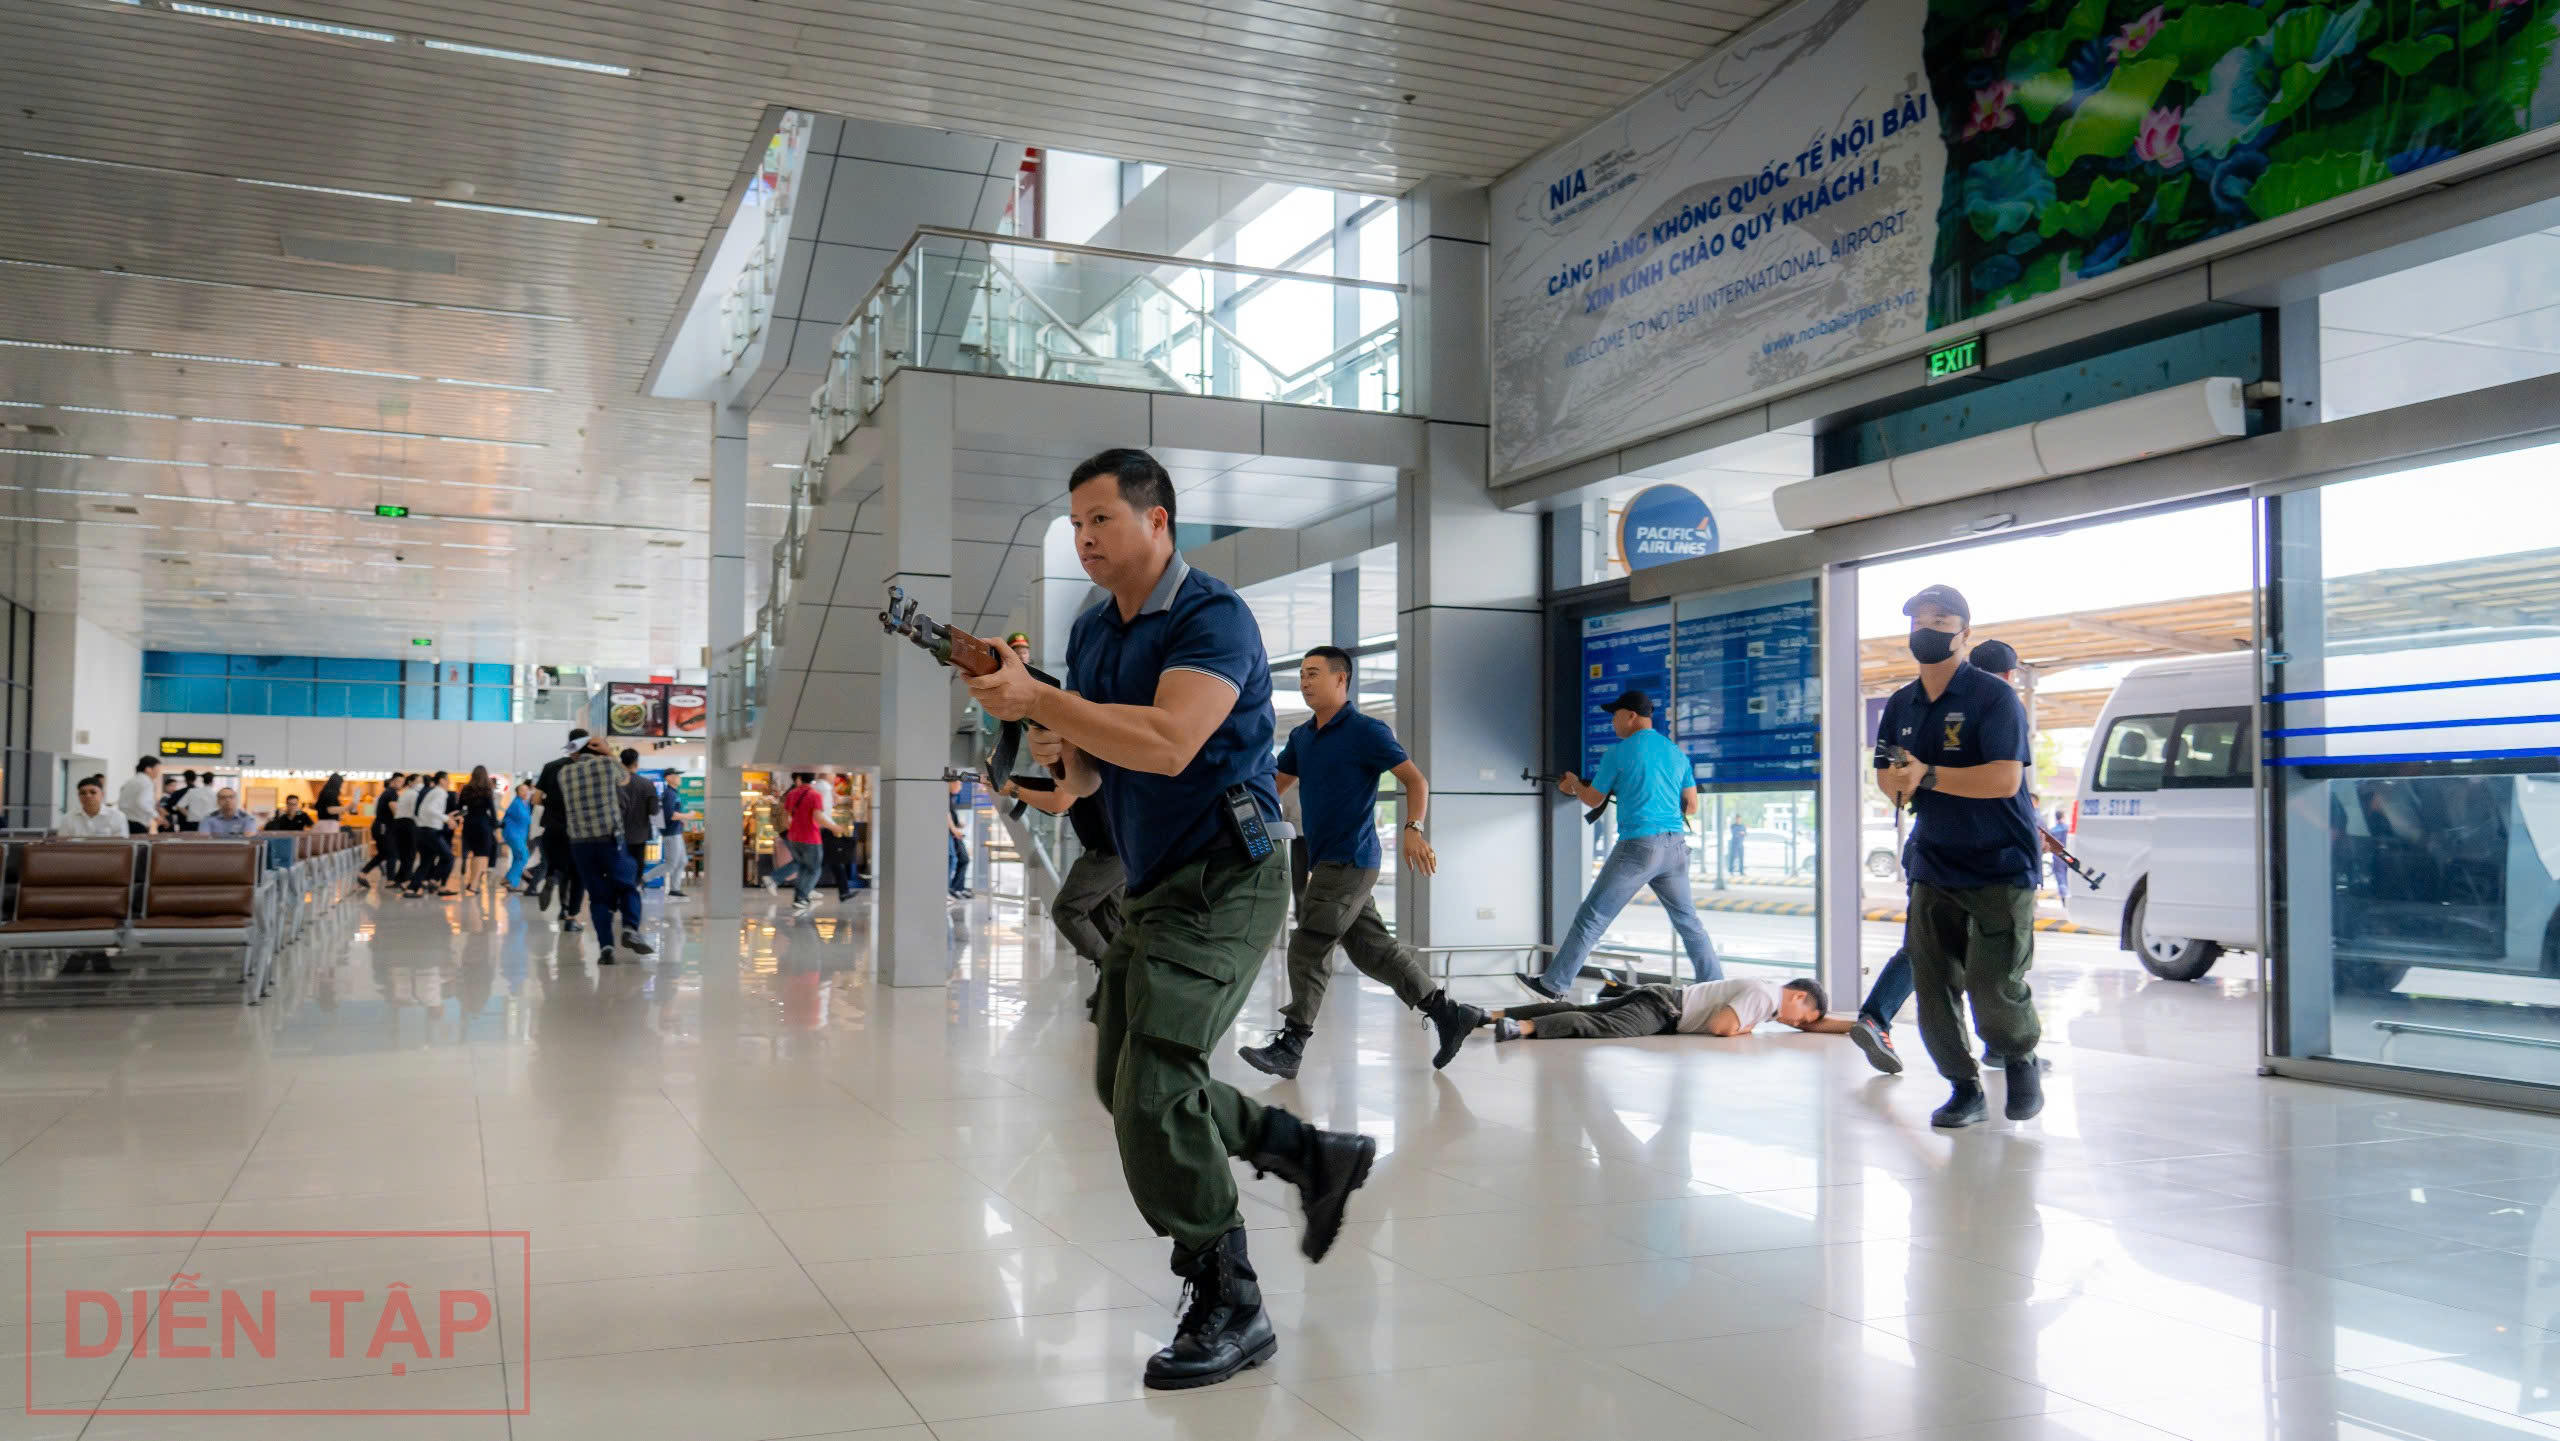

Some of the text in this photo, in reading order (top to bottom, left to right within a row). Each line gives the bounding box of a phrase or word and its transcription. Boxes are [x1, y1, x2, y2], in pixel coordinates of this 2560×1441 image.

[1548, 262, 1593, 296] CẢNG
[1598, 231, 1648, 274] HÀNG
[1652, 196, 1722, 247] KHÔNG
[1727, 159, 1790, 213] QUỐC
[1796, 132, 1826, 177] TẾ
[1830, 119, 1874, 163] NỘI
[1882, 93, 1927, 137] BÀI
[1550, 168, 1587, 210] NIA
[1585, 282, 1615, 315] XIN
[1619, 260, 1663, 298] KÍNH
[1668, 234, 1725, 276] CHÀO
[1731, 201, 1777, 250] QUÝ
[1782, 176, 1865, 226] KHÁCH
[1564, 328, 1625, 369] WELCOME
[1627, 320, 1647, 341] TO
[1676, 296, 1700, 324] BAI
[1700, 246, 1826, 313] INTERNATIONAL
[1830, 207, 1909, 265] AIRPORT
[1931, 342, 1977, 378] EXIT
[1636, 526, 1694, 541] PACIFIC
[1637, 540, 1707, 556] AIRLINES
